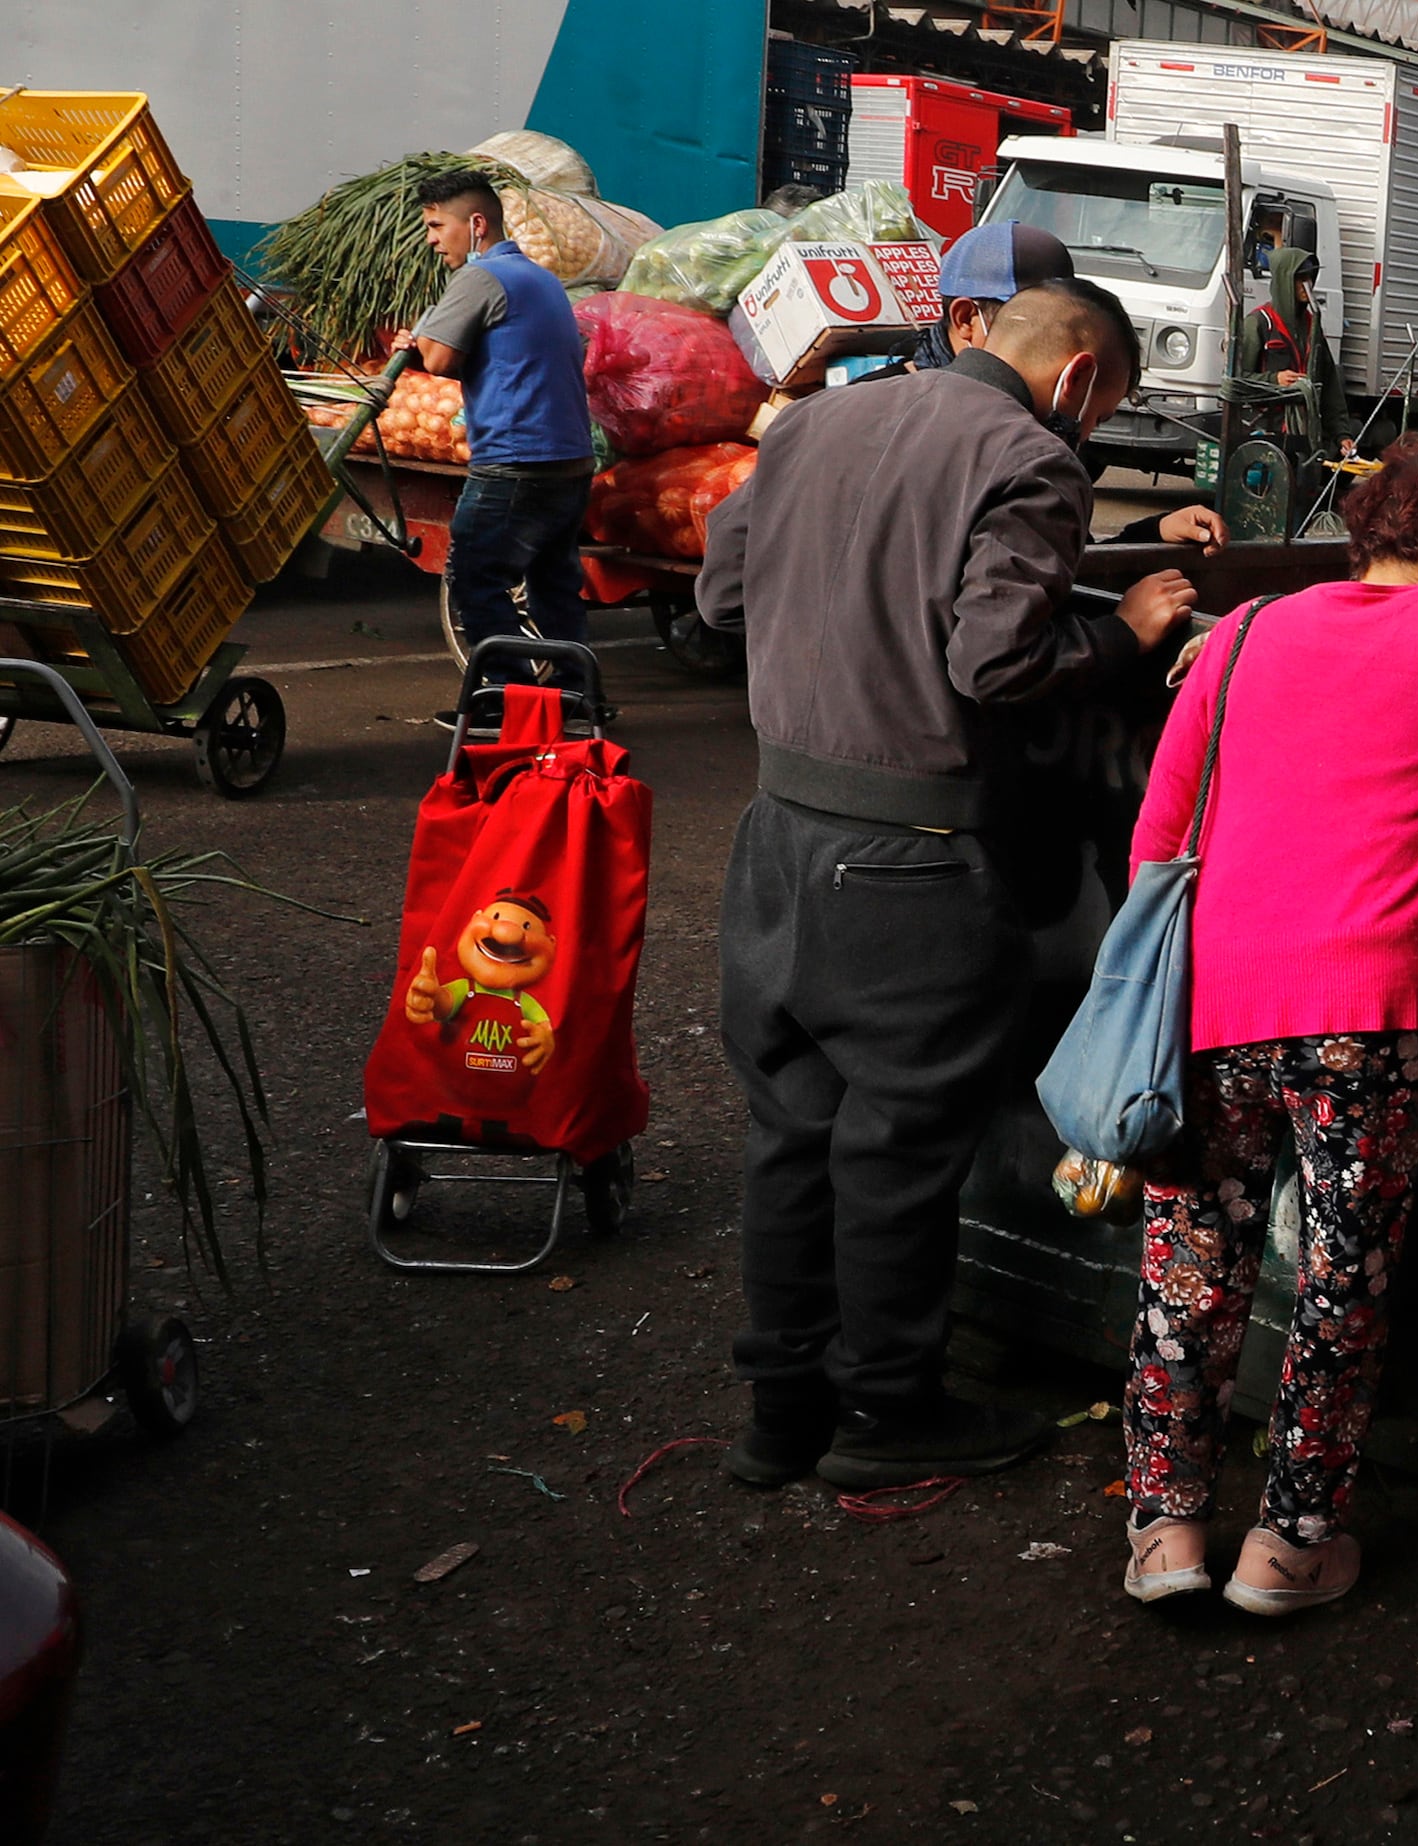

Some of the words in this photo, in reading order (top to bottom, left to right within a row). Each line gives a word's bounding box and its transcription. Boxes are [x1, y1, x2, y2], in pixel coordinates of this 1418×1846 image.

[1213, 64, 1286, 81] BENFOR
[934, 139, 981, 168] GT
[799, 245, 861, 259] unifrutti
[874, 246, 931, 260] APPLES
[882, 260, 938, 273] APPLES
[755, 256, 792, 302] unifrutti
[890, 274, 941, 288] APLES
[897, 289, 942, 303] APPLE
[469, 1019, 513, 1052] MAX
[468, 1056, 514, 1070] SURTIMAX
